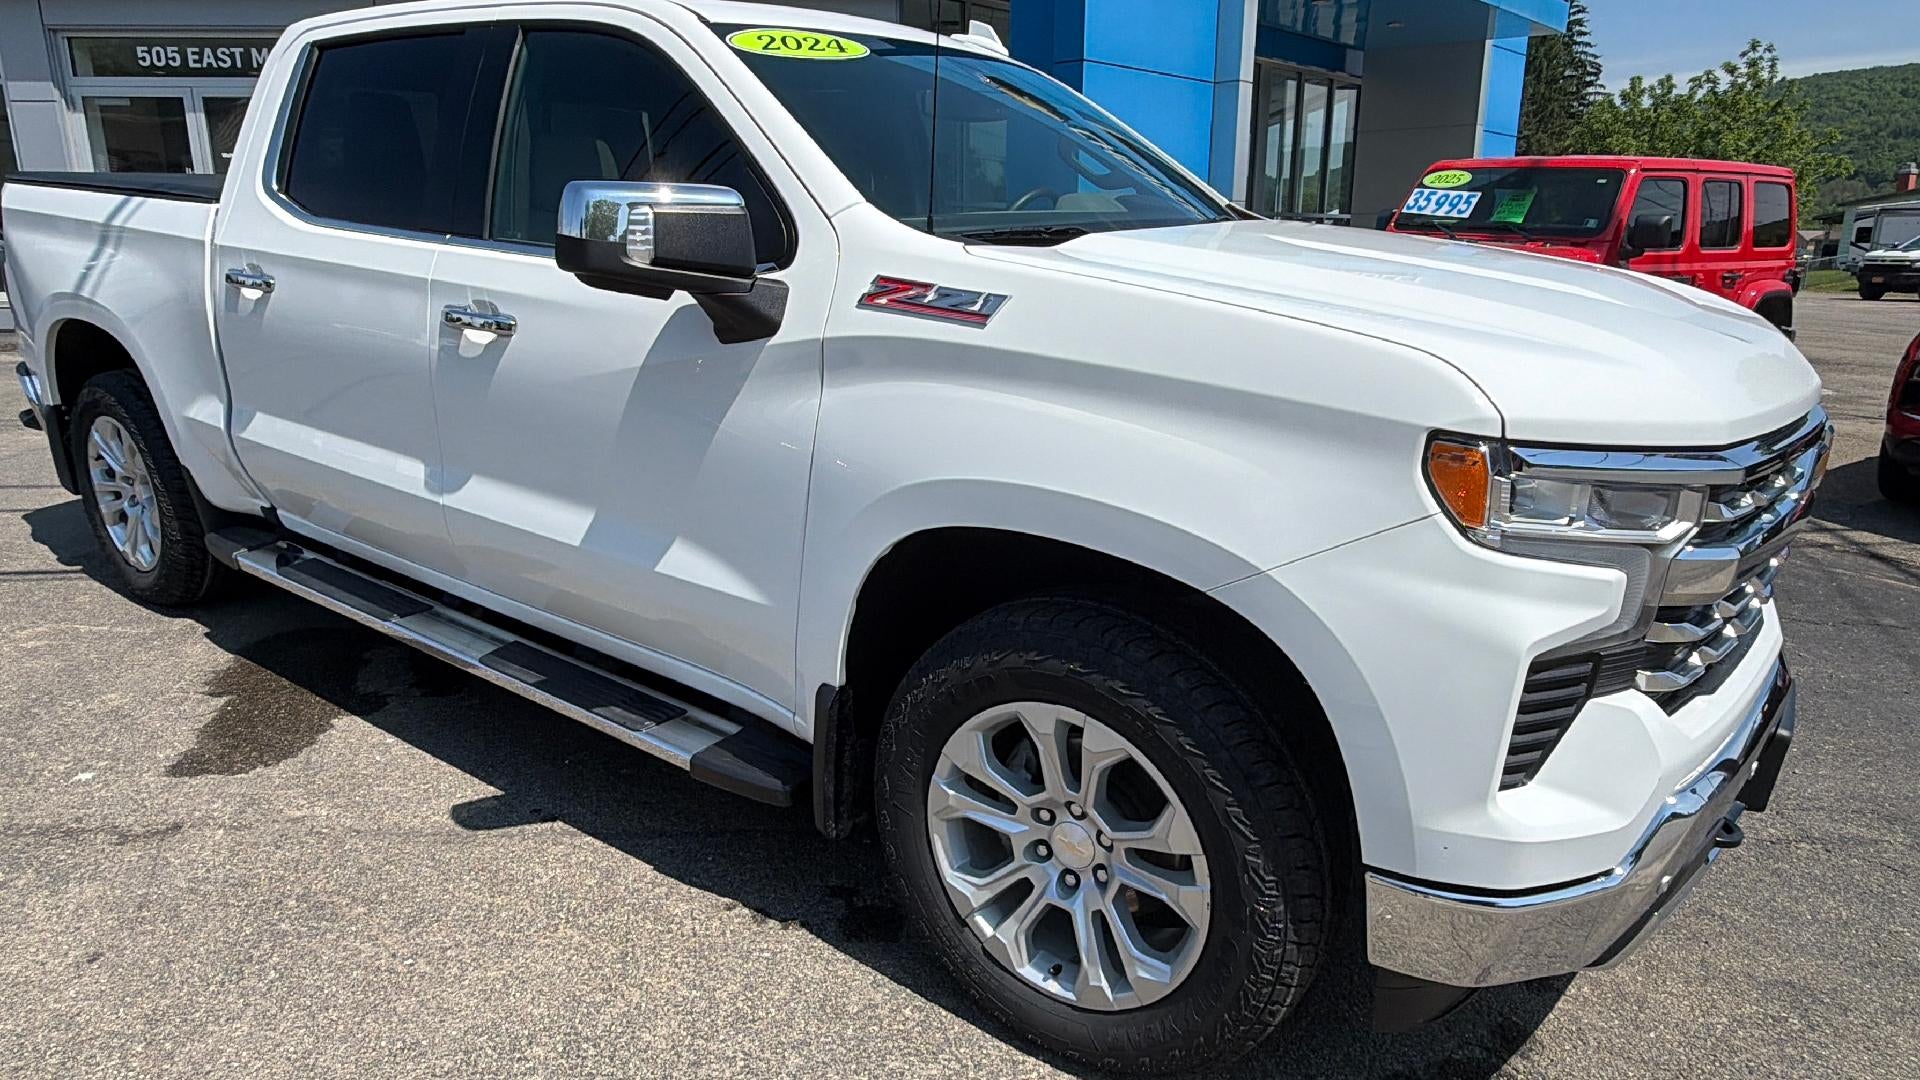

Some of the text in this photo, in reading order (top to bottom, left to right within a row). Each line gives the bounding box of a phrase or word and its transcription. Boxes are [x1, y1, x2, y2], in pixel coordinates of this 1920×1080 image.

[757, 34, 848, 53] 2024
[136, 46, 181, 67] 505
[187, 47, 244, 68] EAST
[1430, 173, 1465, 185] 2025
[1406, 190, 1477, 215] 35995
[857, 275, 1011, 326] Z71
